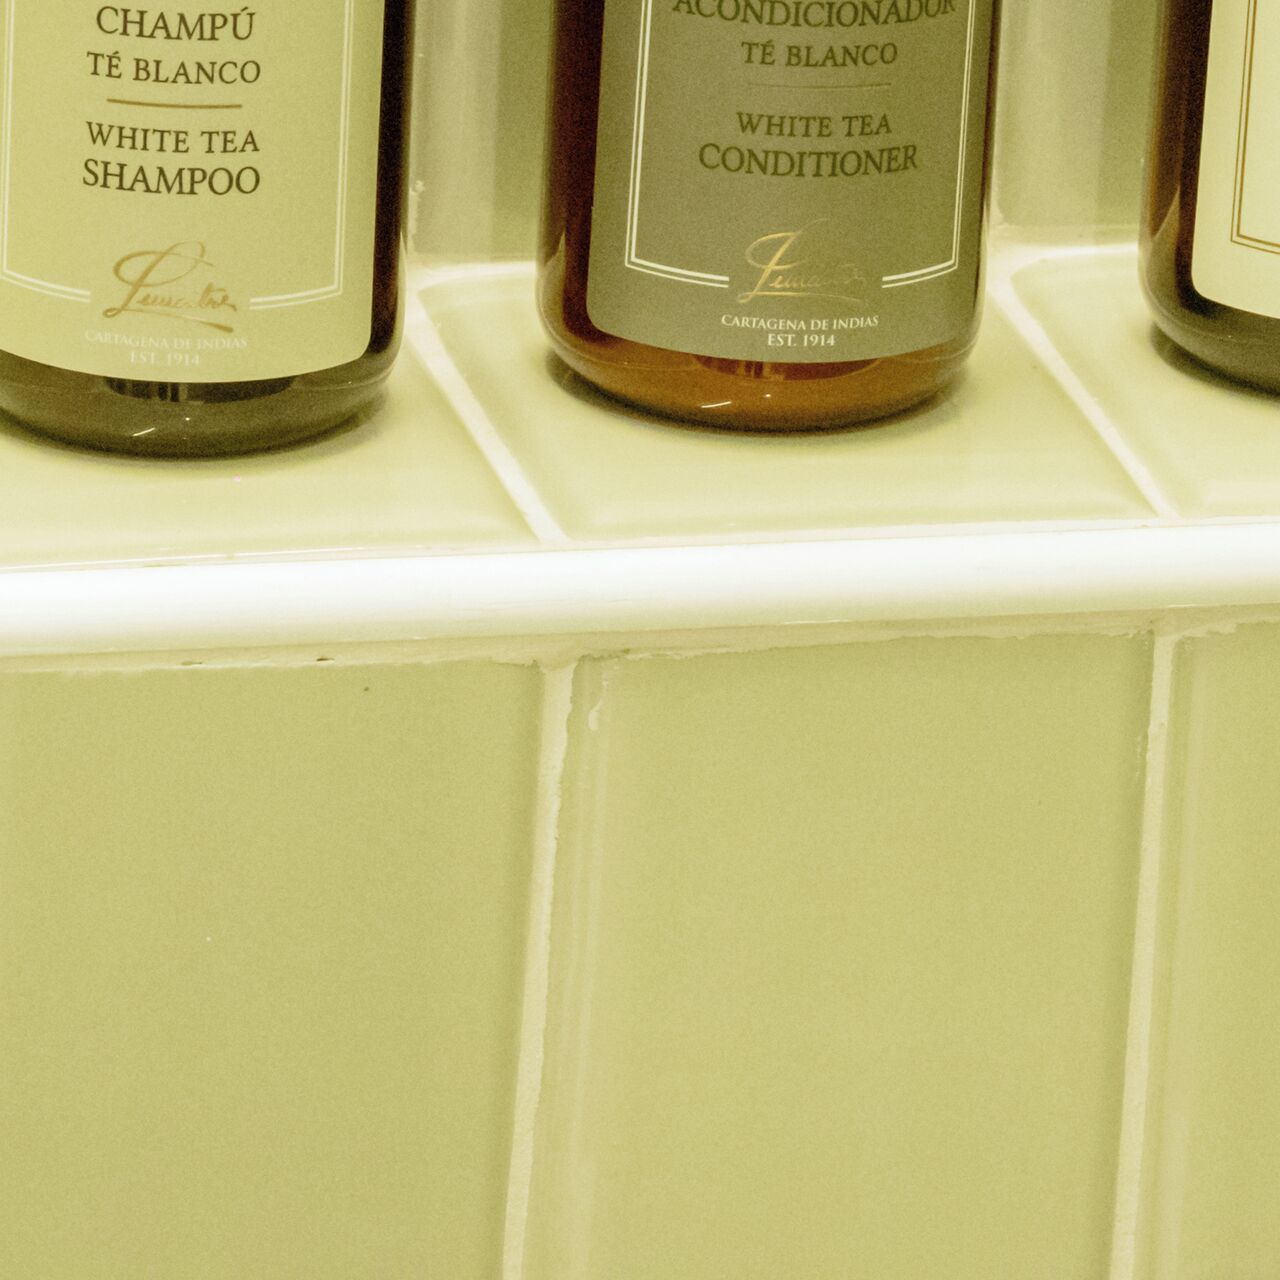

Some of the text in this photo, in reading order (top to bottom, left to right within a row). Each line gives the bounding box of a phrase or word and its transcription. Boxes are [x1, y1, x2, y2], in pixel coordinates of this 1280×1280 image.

[96, 5, 256, 41] CHAMPÚ
[86, 51, 261, 85] TÉ BLANCO
[740, 39, 898, 68] TÉ BLANCO
[86, 121, 261, 154] WHITE TEA
[736, 111, 893, 138] WHITE TEA
[698, 143, 919, 178] CONDITIONER
[82, 158, 261, 196] SHAMPOO
[721, 314, 880, 332] CARTAGENA DE INDIAS
[84, 328, 248, 350] CARTAGENA DE INDIAS
[767, 333, 836, 347] EST. 1914
[166, 351, 201, 366] 1914
